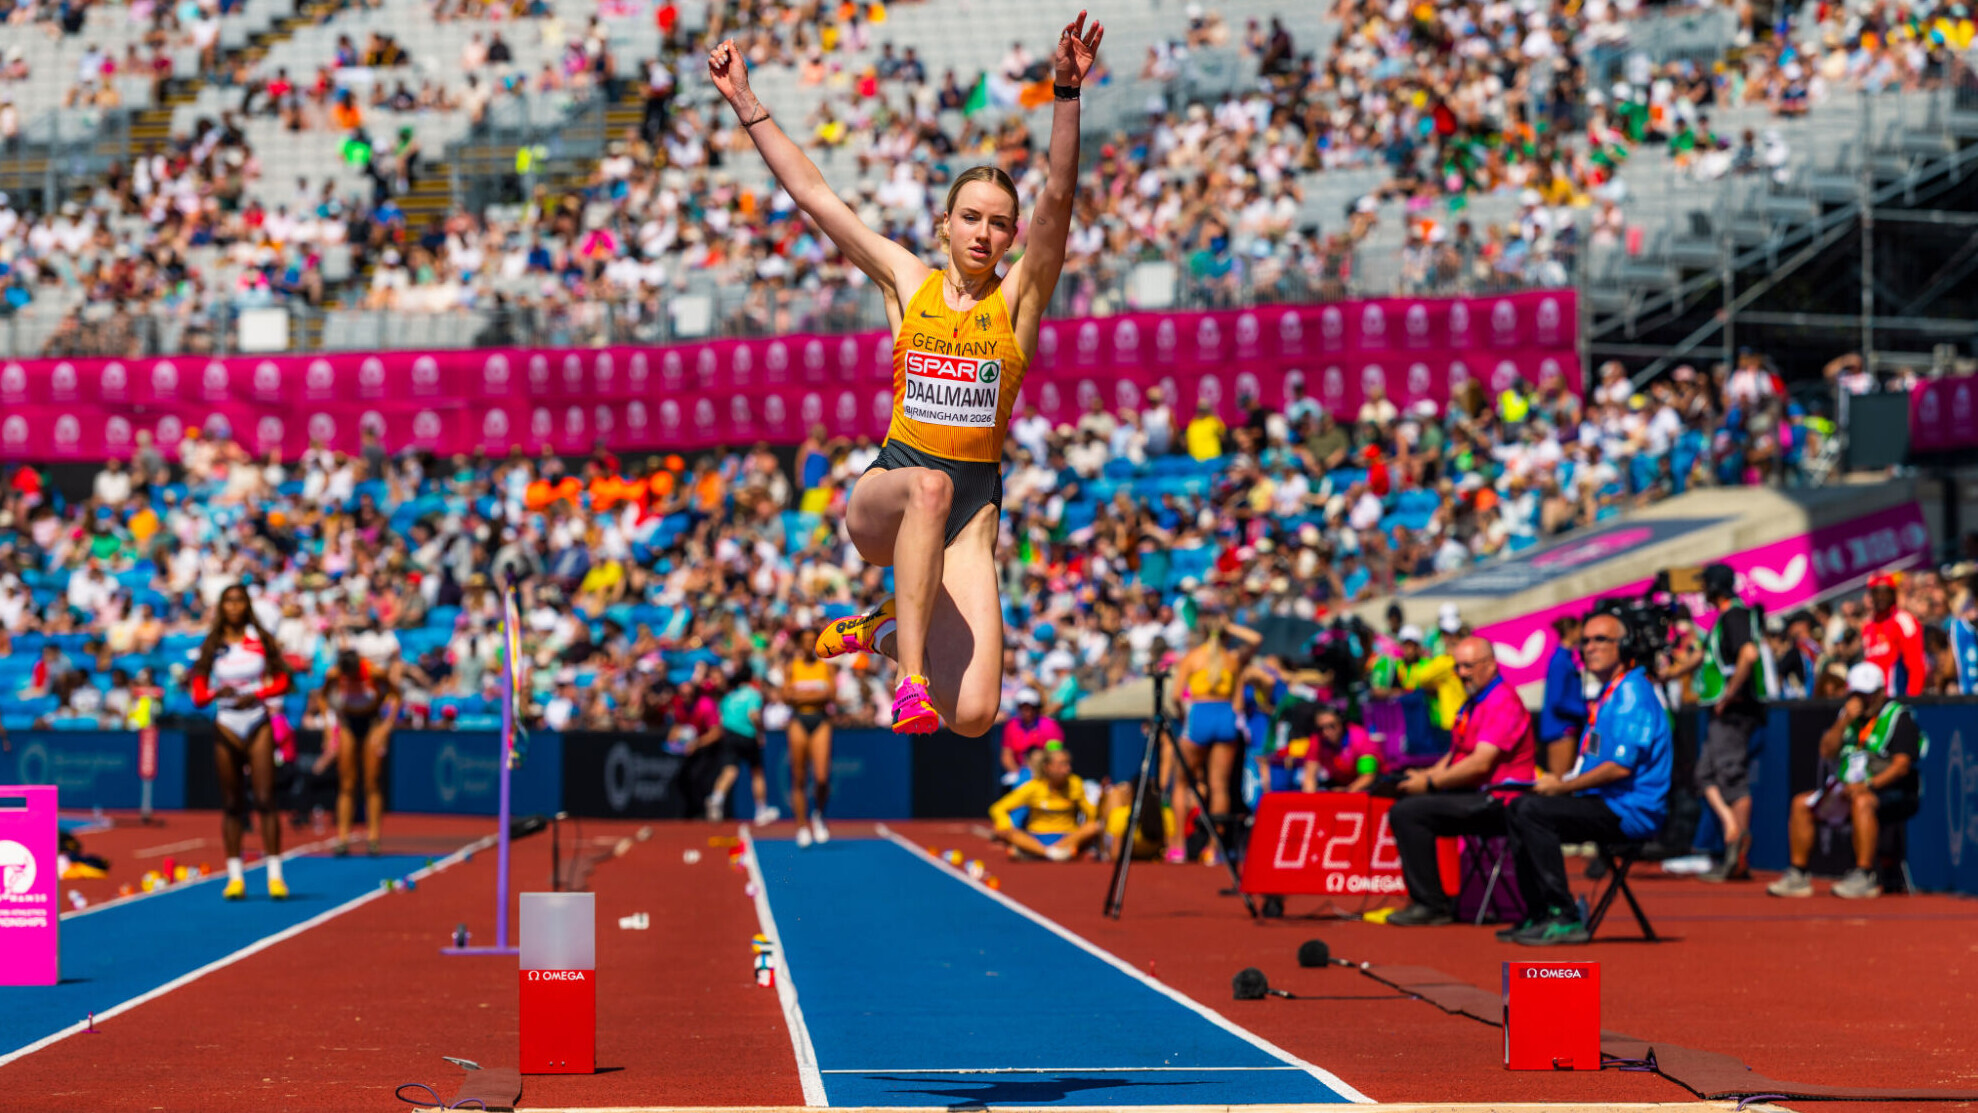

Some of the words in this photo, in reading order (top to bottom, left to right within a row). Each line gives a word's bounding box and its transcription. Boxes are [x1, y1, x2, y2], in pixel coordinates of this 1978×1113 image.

[913, 332, 997, 356] GERMANY
[908, 356, 975, 379] SPAR
[907, 379, 996, 408] DAALMANN
[905, 406, 968, 422] BIRMINGHAM
[970, 414, 992, 423] 2026
[1347, 875, 1405, 892] OMEGA
[542, 971, 585, 981] OMEGA
[1540, 968, 1581, 978] OMEGA
